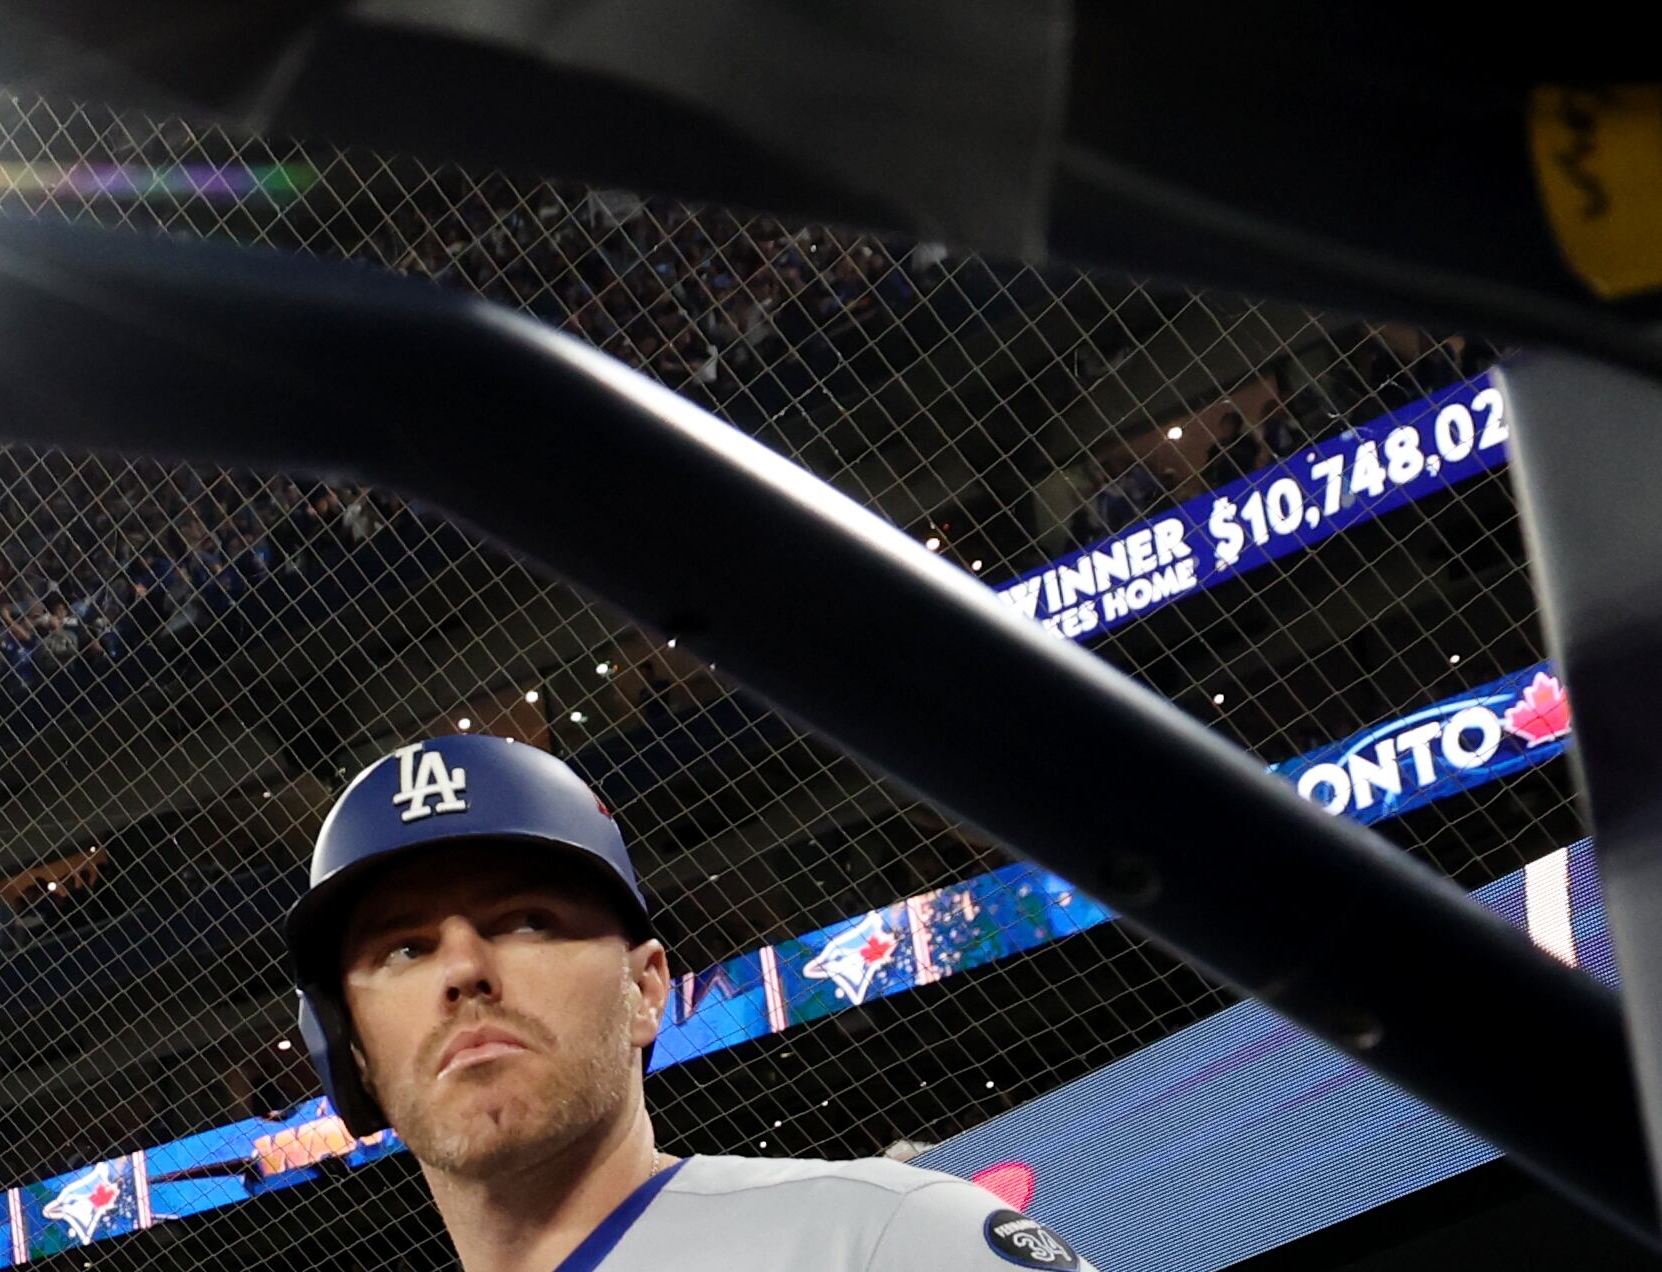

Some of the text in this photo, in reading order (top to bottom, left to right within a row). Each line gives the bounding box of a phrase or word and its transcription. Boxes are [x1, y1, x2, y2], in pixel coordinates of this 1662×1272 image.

[1209, 388, 1510, 571] $10,748,02
[1042, 558, 1197, 640] KES HOME
[393, 742, 466, 821] LA
[1297, 707, 1501, 816] ONTO
